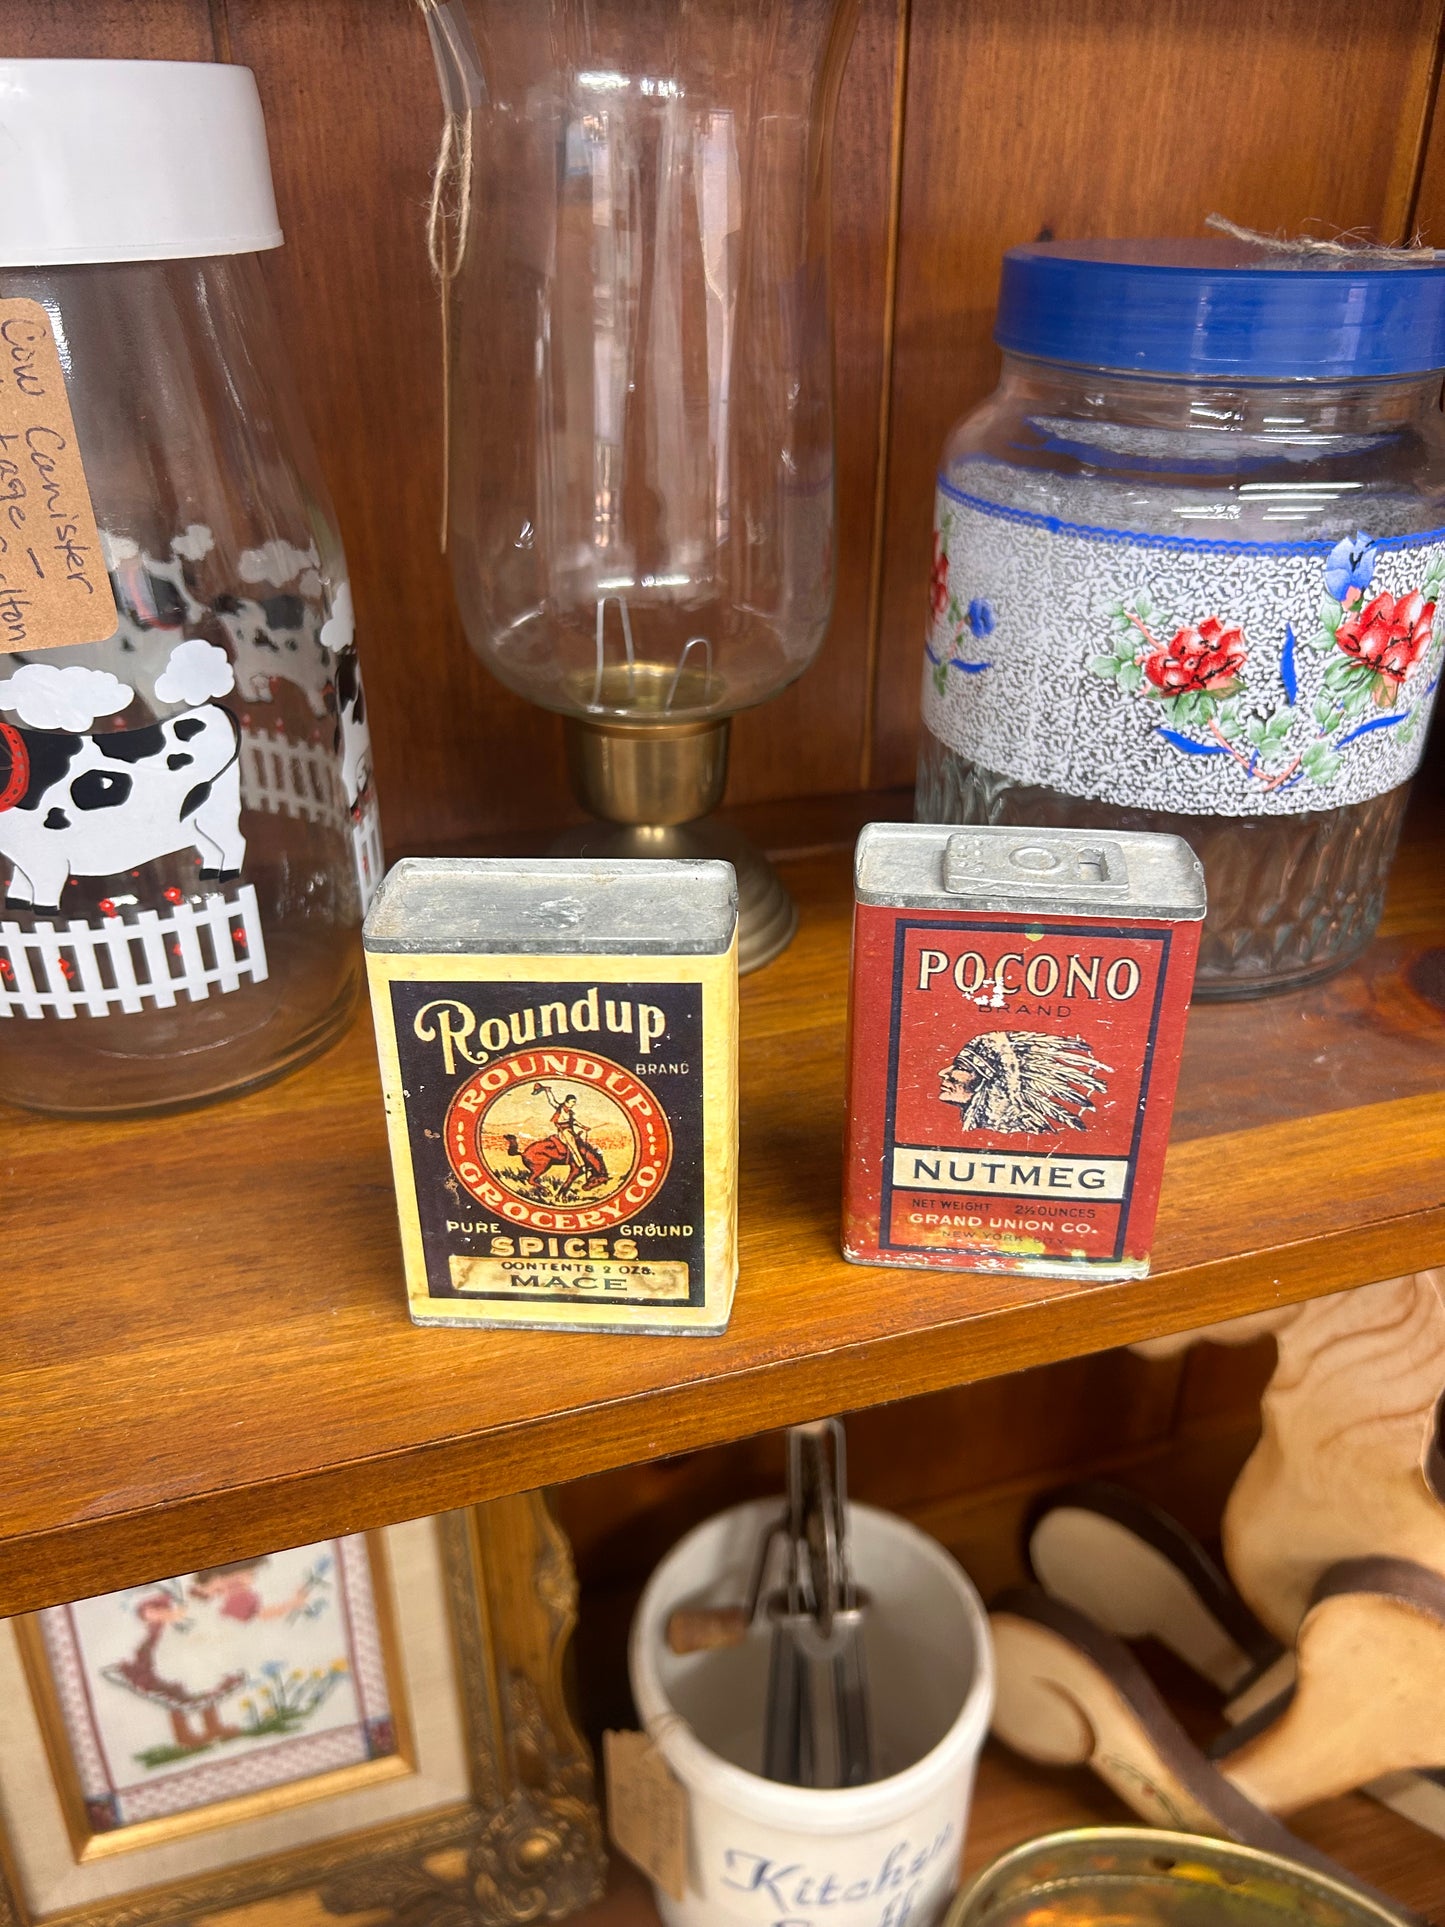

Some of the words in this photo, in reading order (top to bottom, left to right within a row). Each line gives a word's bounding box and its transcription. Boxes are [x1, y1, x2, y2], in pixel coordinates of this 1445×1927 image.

[1, 318, 46, 396] Cow
[25, 426, 93, 594] Canister
[917, 948, 1141, 1001] POCONO
[978, 1003, 1072, 1018] BRAND
[414, 987, 666, 1075] Roundup
[636, 1062, 690, 1075] BRAND
[458, 1055, 653, 1117] ROUNDUP
[913, 1158, 1107, 1190] NUTMEG
[459, 1161, 624, 1230] GROCERY
[625, 1159, 662, 1203] CO.
[912, 1198, 936, 1209] NET
[940, 1200, 993, 1213] WEIGHT
[1036, 1205, 1097, 1219] OUNCES
[447, 1220, 502, 1234] PURE
[619, 1222, 695, 1237] GROUND
[910, 1212, 983, 1228] GRAND
[989, 1217, 1055, 1232] UNION
[1061, 1223, 1099, 1235] CO.
[489, 1235, 640, 1260] SPICES
[941, 1229, 977, 1240] NEW
[982, 1231, 1024, 1243] YORK
[511, 1274, 629, 1292] MACE
